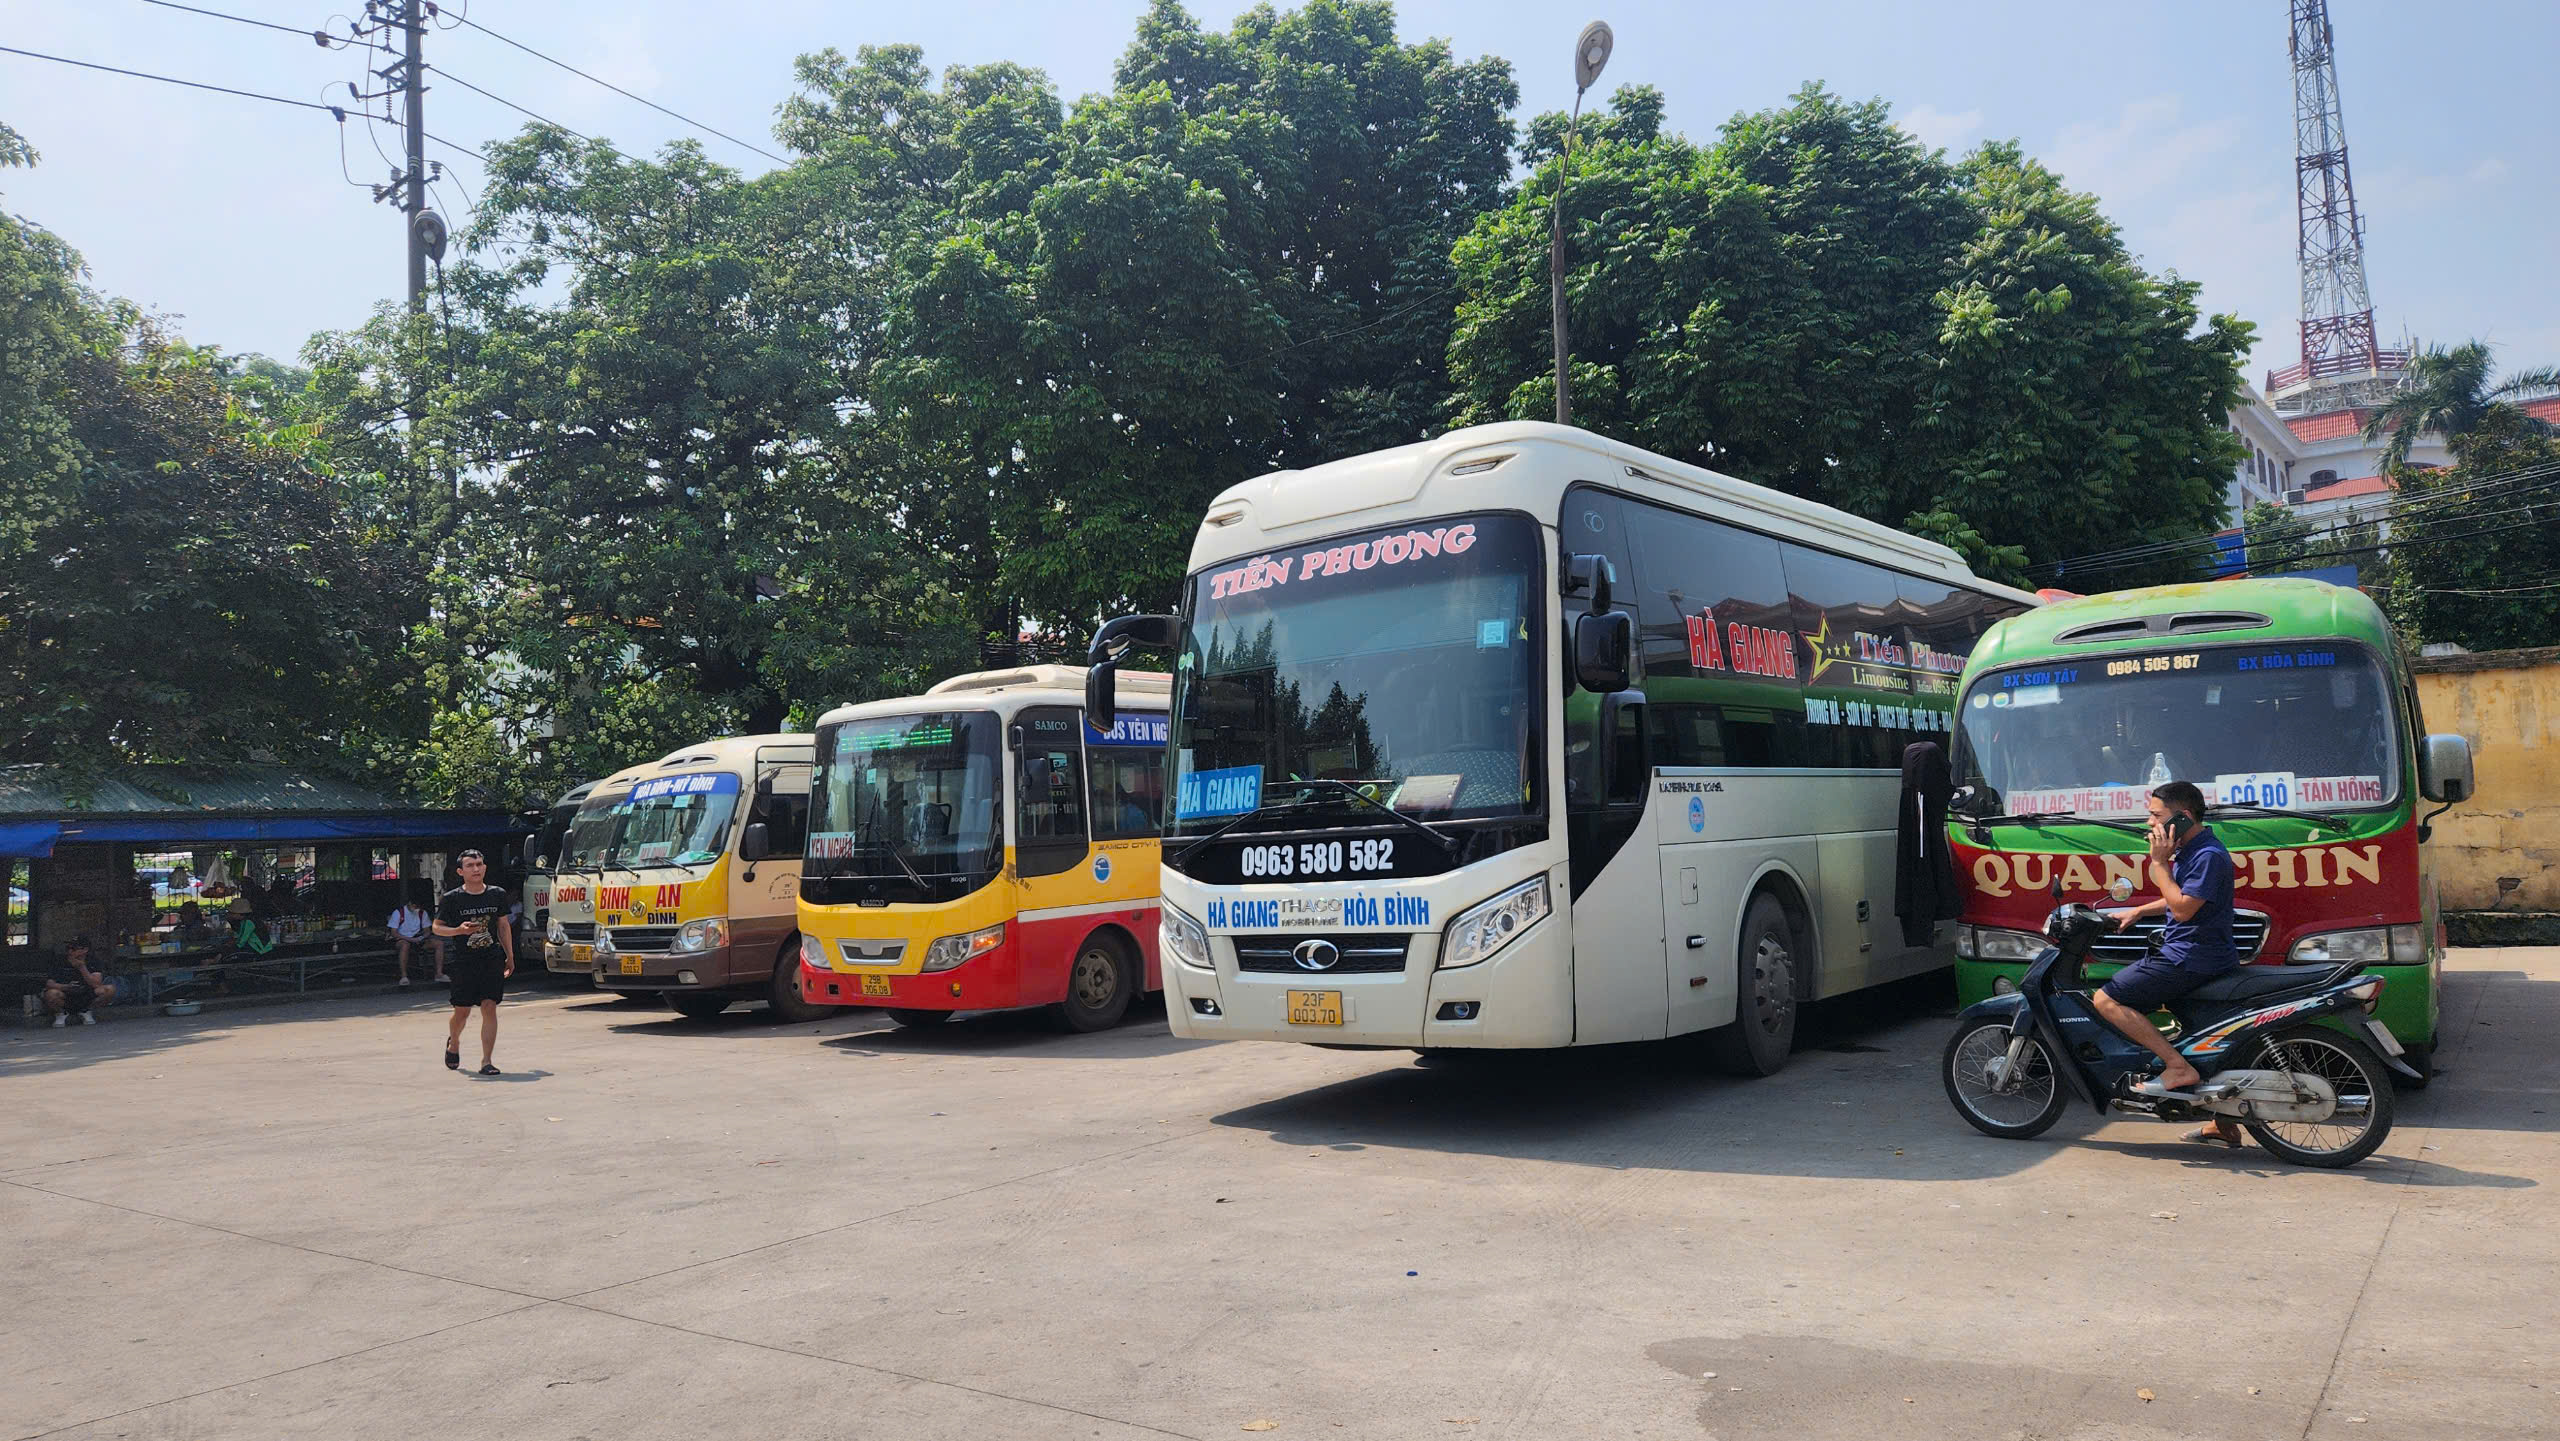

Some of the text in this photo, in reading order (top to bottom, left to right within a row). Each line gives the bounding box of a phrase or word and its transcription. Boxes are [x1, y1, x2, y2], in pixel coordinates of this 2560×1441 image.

[1298, 524, 1477, 581] PHƯƠNG
[1687, 606, 1796, 679] HÀ GIANG
[1854, 631, 1906, 666] Tiến
[2107, 654, 2200, 676] 0984 505 867
[2238, 656, 2258, 671] BX
[2262, 648, 2294, 669] HÒA
[1851, 666, 1910, 691] Limousine
[2003, 674, 2021, 688] BX
[2054, 667, 2078, 684] TÂY
[1805, 697, 1830, 725] TRUNG
[1829, 695, 1841, 725] HÀ
[1845, 700, 1860, 727] SƠN
[1034, 720, 1068, 731] SAMCO
[1127, 717, 1150, 741] YÊN
[1151, 722, 1167, 742] NG
[1179, 774, 1258, 814] HÀ GIANG
[2109, 791, 2133, 810] 105
[2262, 777, 2288, 808] ĐÔ
[2336, 775, 2382, 802] HỒNG
[1241, 838, 1394, 877] 0963 580 582
[655, 883, 682, 909] AN
[1279, 897, 1343, 913] THACO
[460, 908, 477, 916] LOUIS
[647, 909, 677, 925] ĐÌNH
[1208, 896, 1279, 928] HÀ GIANG
[1343, 891, 1430, 927] HÒA BÌNH
[1303, 992, 1326, 1007] 23F
[1294, 1008, 1336, 1024] 003.70
